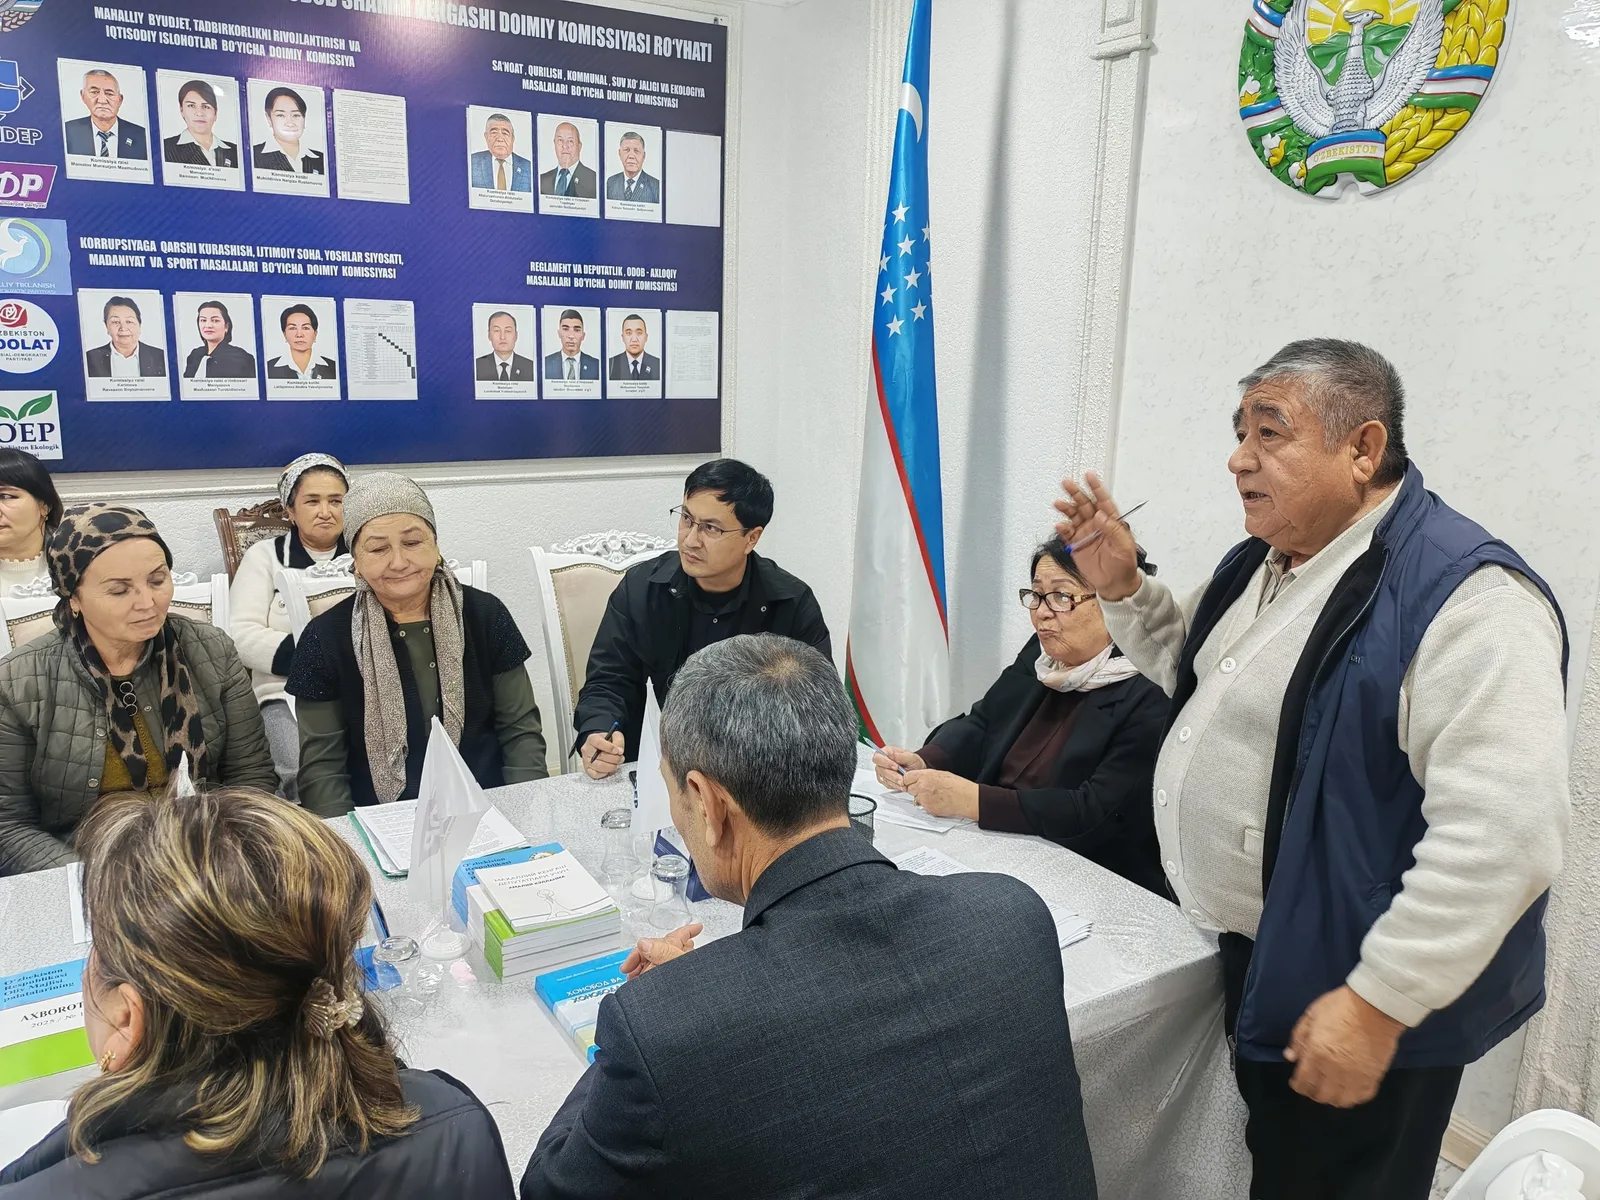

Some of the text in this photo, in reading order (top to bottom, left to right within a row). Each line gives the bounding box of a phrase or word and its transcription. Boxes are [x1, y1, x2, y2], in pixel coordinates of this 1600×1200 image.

[94, 6, 361, 52] MAHALLIY BYUDJET, TADBIRKORLIKNI RIVOJLANTIRISH VA
[499, 11, 555, 39] DOIMIY
[558, 20, 650, 54] KOMISSIYASI
[653, 35, 712, 62] RO'YHATI
[105, 25, 355, 67] IQTISODIY ISLOHOTLAR BO'YICHA DOIMIY KOMISSIYA
[528, 65, 562, 79] QURILISH
[567, 70, 608, 86] KOMMUNAL
[611, 76, 626, 88] SUV
[639, 80, 660, 92] JALIGI
[660, 82, 670, 94] VA
[670, 84, 705, 98] EKOLOGIYA
[522, 78, 679, 109] MASALALARI BO'YICHA DOIMIY KOMISSIYASI
[0, 126, 43, 145] DEP
[1313, 144, 1378, 162] O'ZBEKISTON
[0, 171, 43, 198] DP
[79, 237, 404, 266] KORRUPSIYAGA QARSHI KURASHISH, IJTIMOIY SOHA, YOSHLAR SIYOSATI,
[88, 253, 397, 279] MADANIYAT VA SPORT MASALALARI BO'YICHA DOIMIY KOMISSIYASI
[530, 261, 571, 274] REGLAMENT
[572, 264, 583, 274] VA
[583, 265, 623, 277] DEPUTATLIK
[626, 267, 646, 277] ODOB
[650, 268, 678, 279] AXLOQIY
[526, 275, 678, 292] MASALALARI BO'YICHA DOIMIY KOMISSIYASI
[4, 968, 63, 985] O'zbekiston
[4, 973, 68, 990] Respublikasi
[4, 979, 63, 996] Oliy Majlisi
[4, 982, 75, 1002] palatalarining
[566, 980, 610, 997] ХОНОБОД
[31, 1019, 55, 1028] 2025
